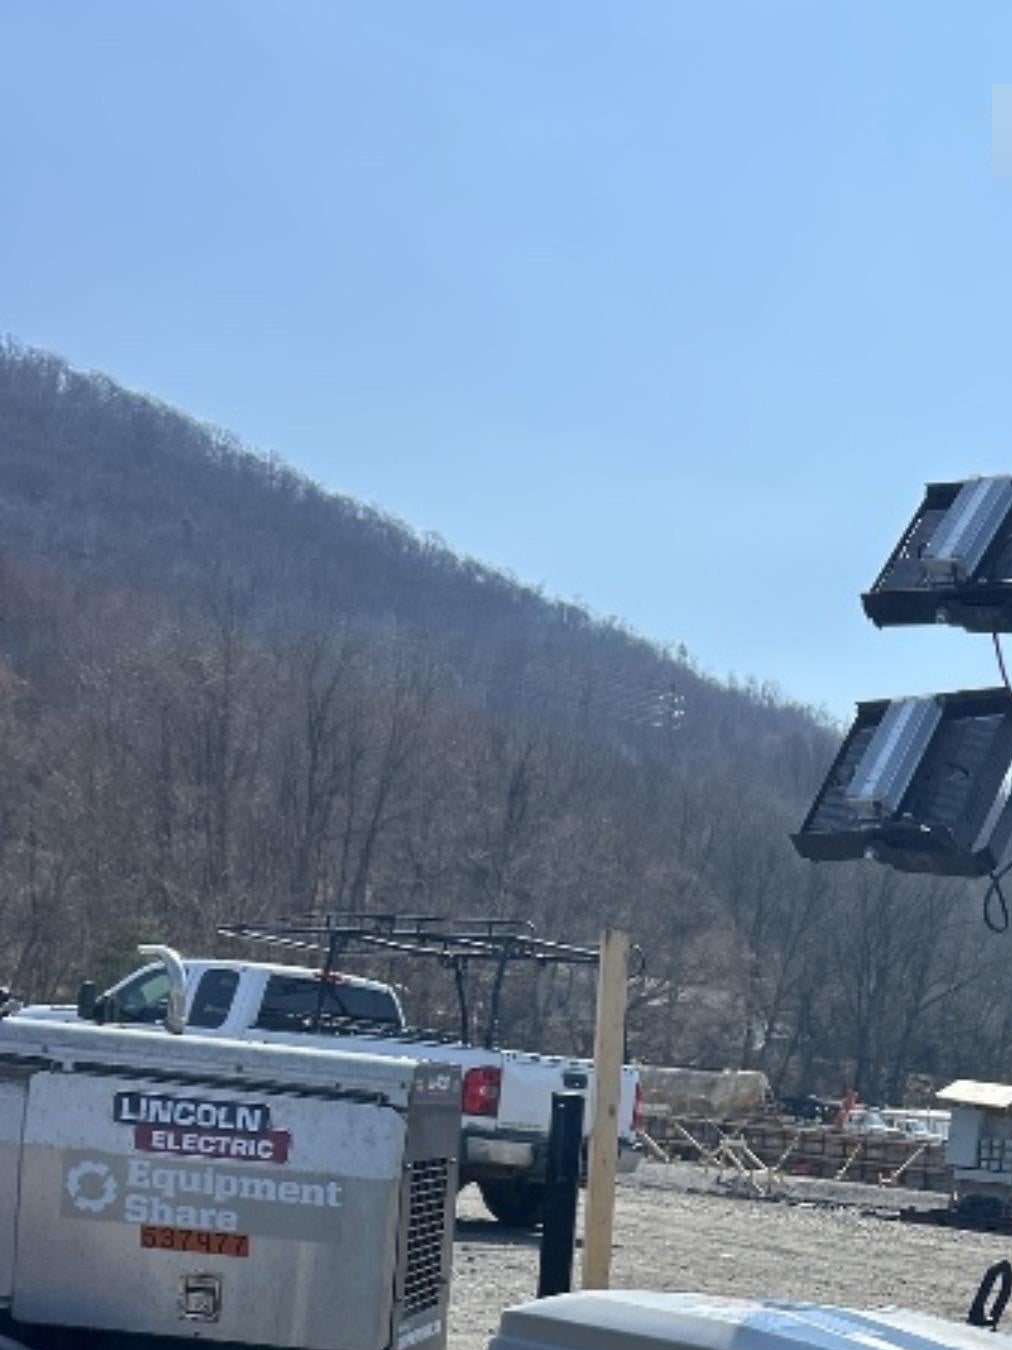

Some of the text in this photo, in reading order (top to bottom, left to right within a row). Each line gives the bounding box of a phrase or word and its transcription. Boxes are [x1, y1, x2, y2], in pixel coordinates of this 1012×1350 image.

[120, 1096, 262, 1132] LINCOLN
[151, 1130, 274, 1159] ELECTRIC
[125, 1157, 343, 1207] Equipment
[123, 1193, 239, 1231] Share
[143, 1226, 248, 1257] 537477
